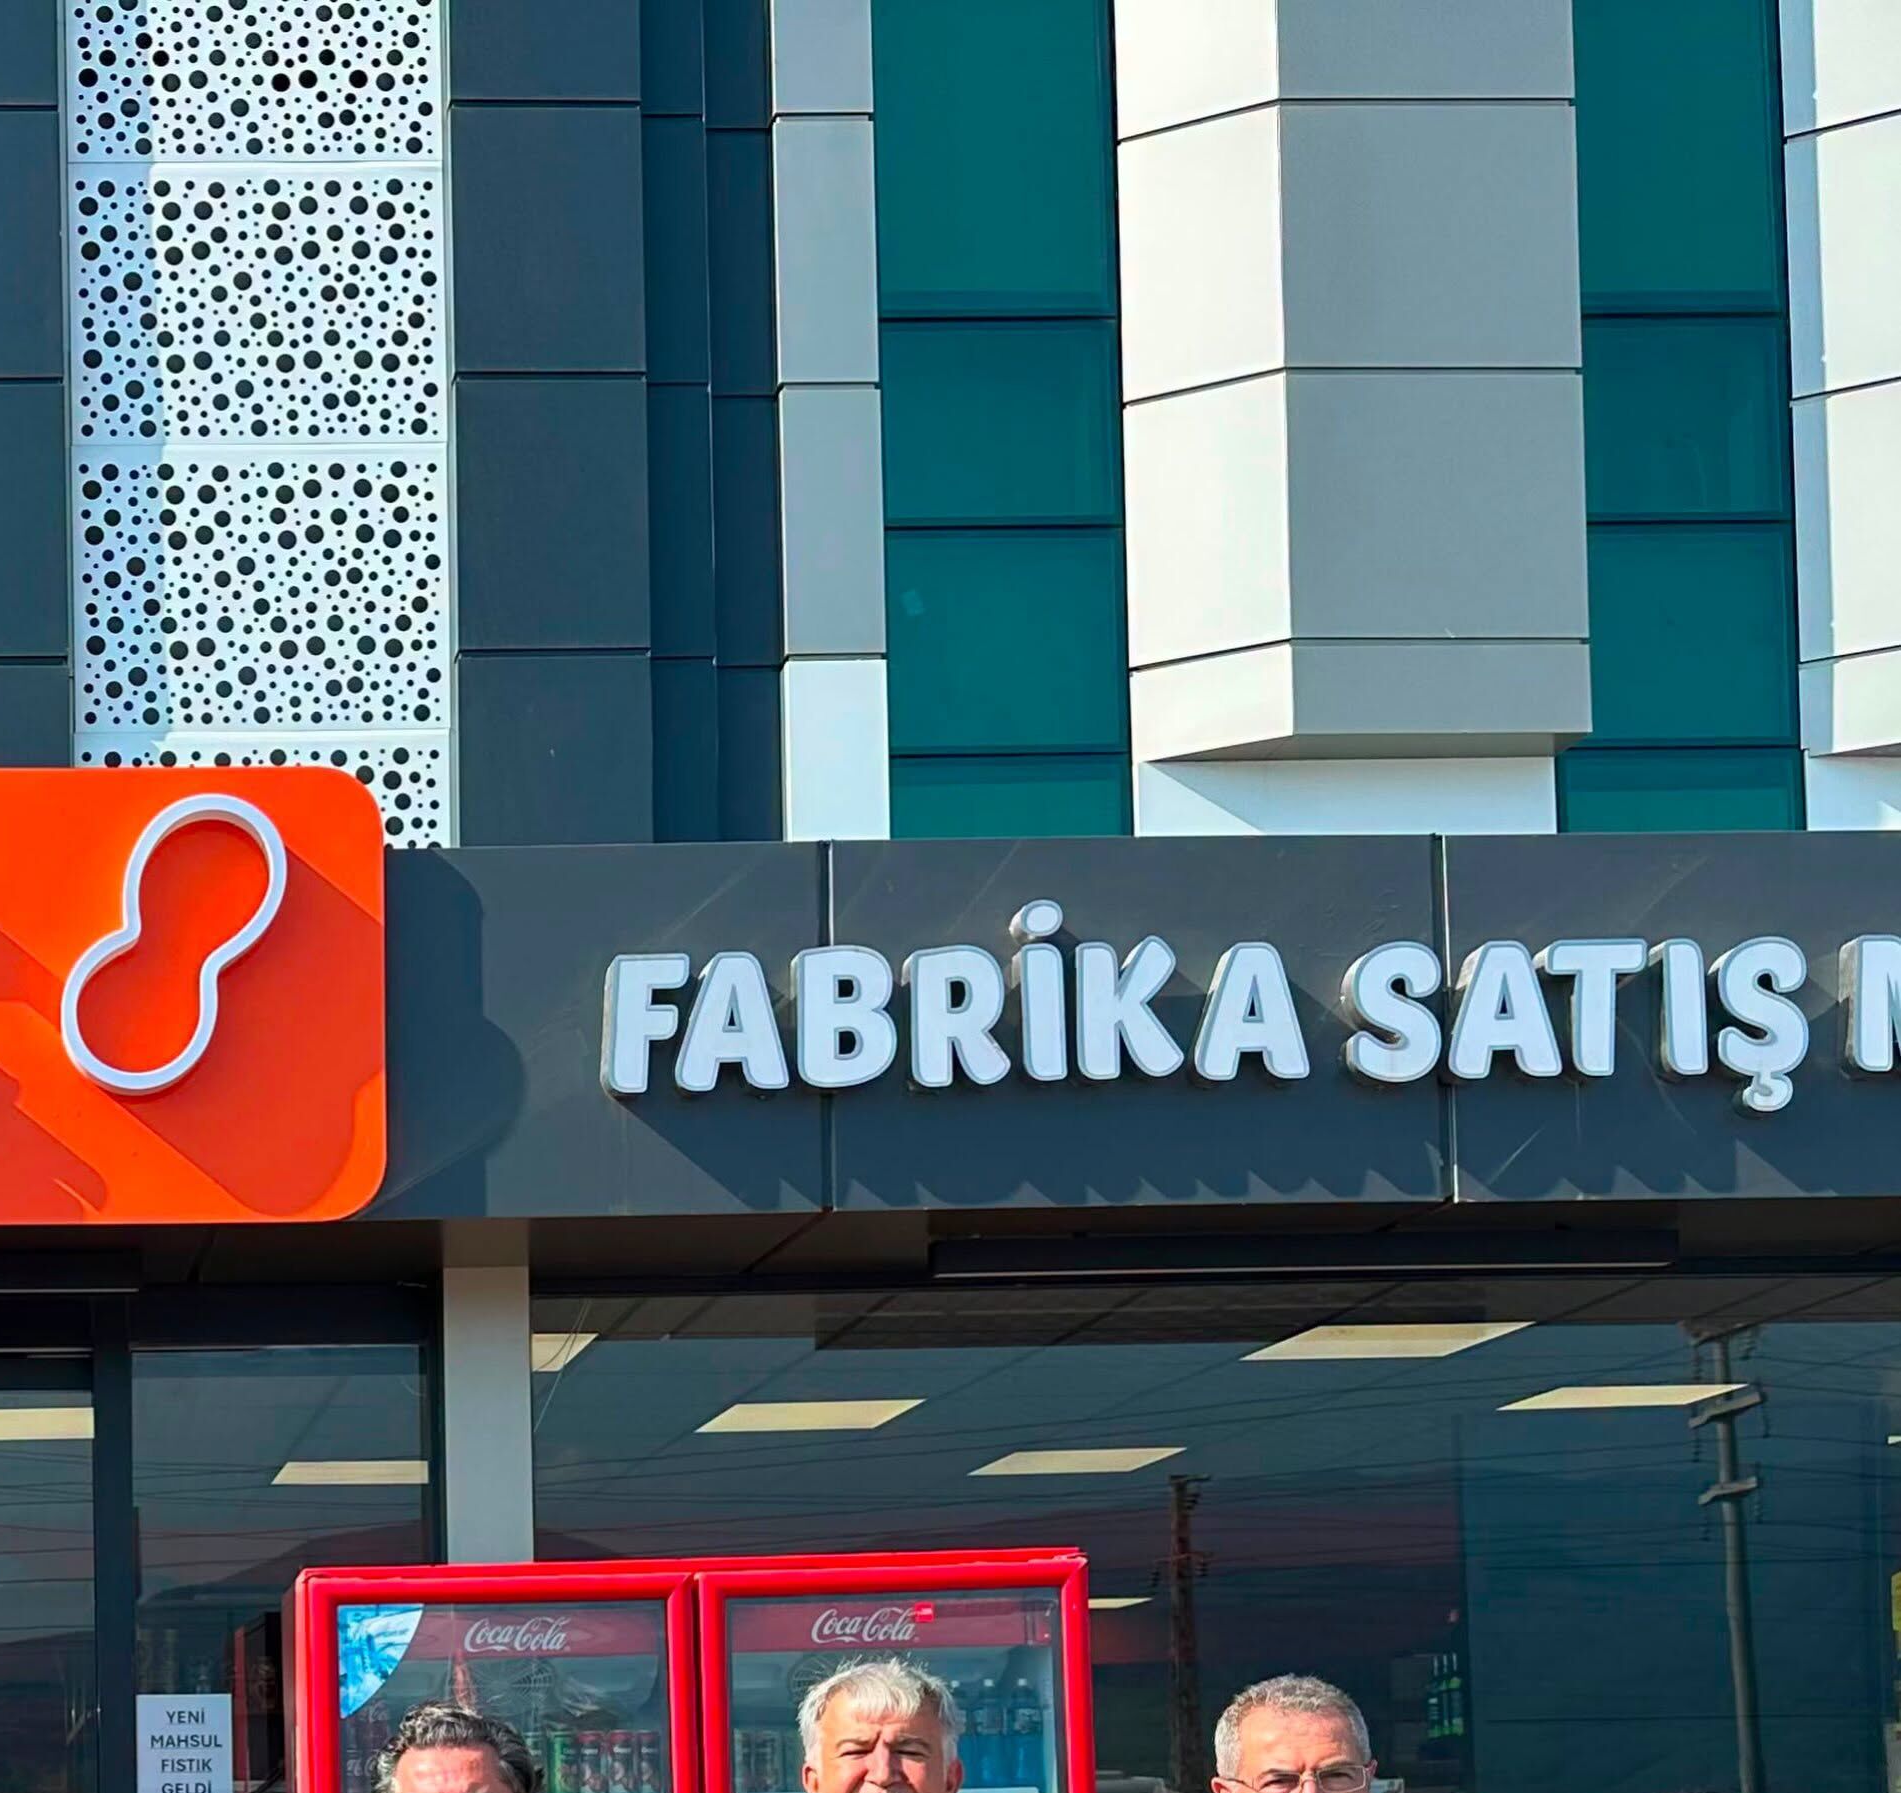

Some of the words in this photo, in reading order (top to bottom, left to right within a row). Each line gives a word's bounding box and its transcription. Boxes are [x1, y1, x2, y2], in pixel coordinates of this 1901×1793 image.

[605, 900, 1309, 1093] FABRİKA
[1347, 937, 1809, 1112] SATIŞ
[166, 1708, 206, 1725] YENİ
[150, 1734, 223, 1749] MAHSUL
[160, 1758, 213, 1773] FISTIK
